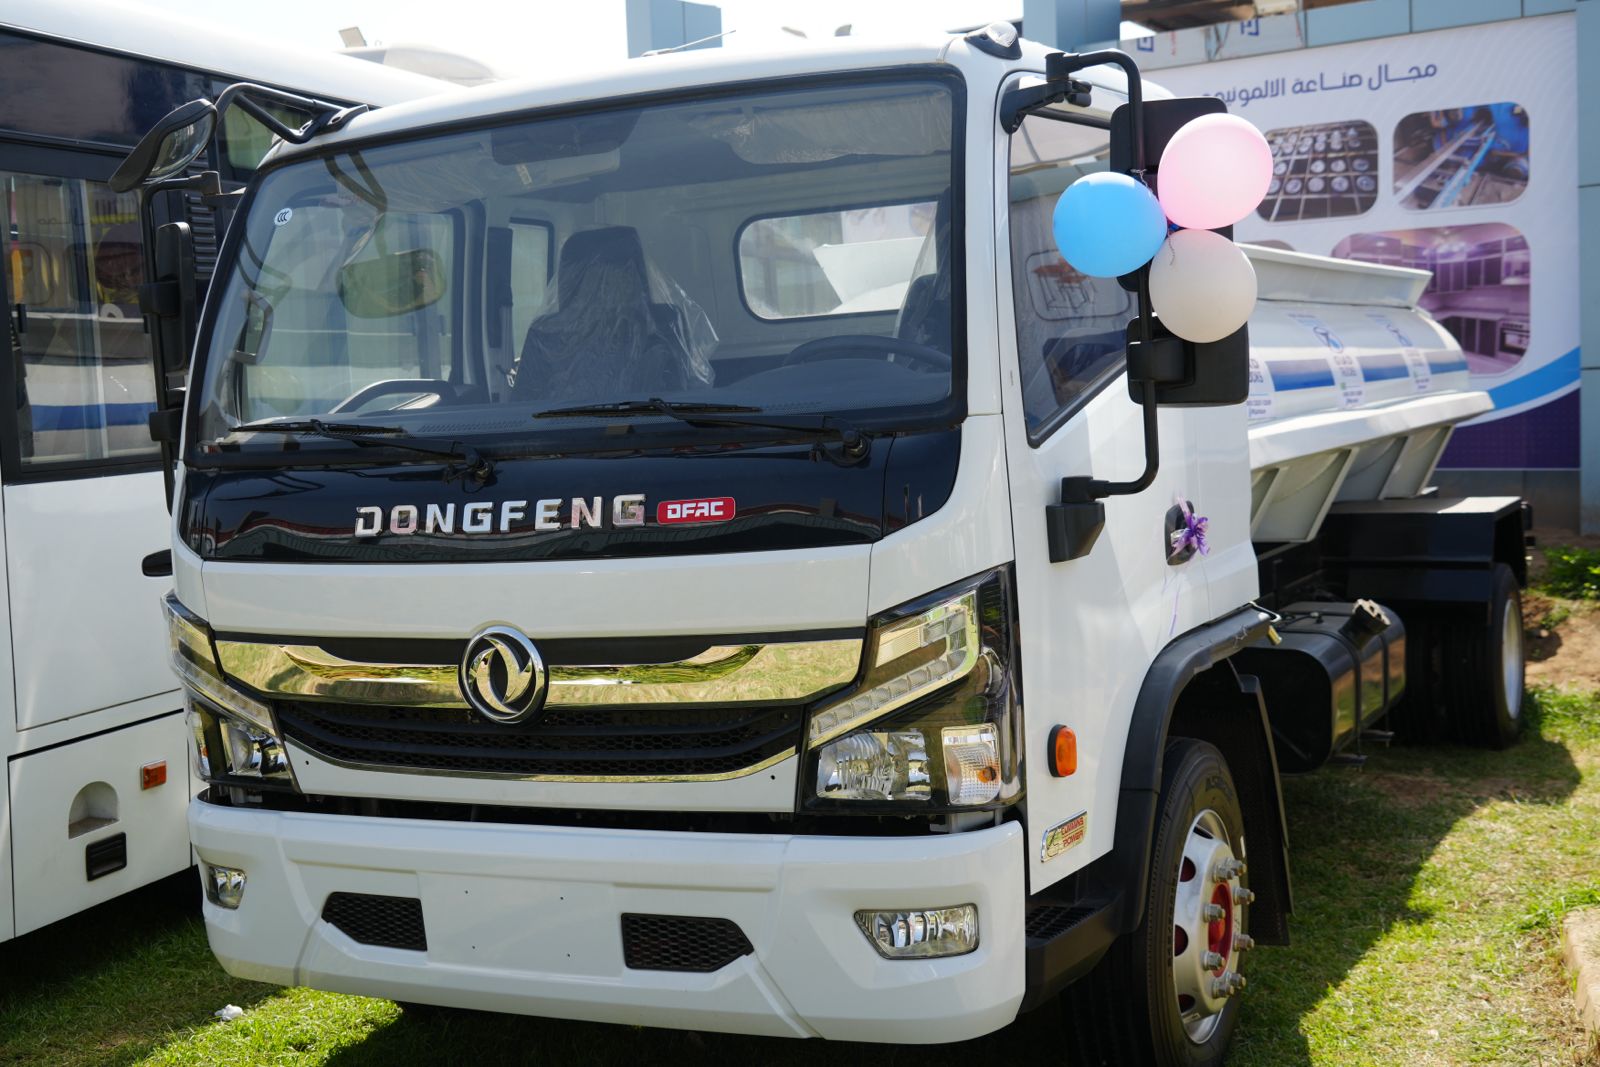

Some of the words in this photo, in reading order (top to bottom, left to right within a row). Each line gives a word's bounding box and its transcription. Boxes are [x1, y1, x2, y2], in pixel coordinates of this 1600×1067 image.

[354, 493, 647, 538] DONGFENG
[666, 500, 724, 520] DFAC
[1062, 829, 1085, 848] POWER
